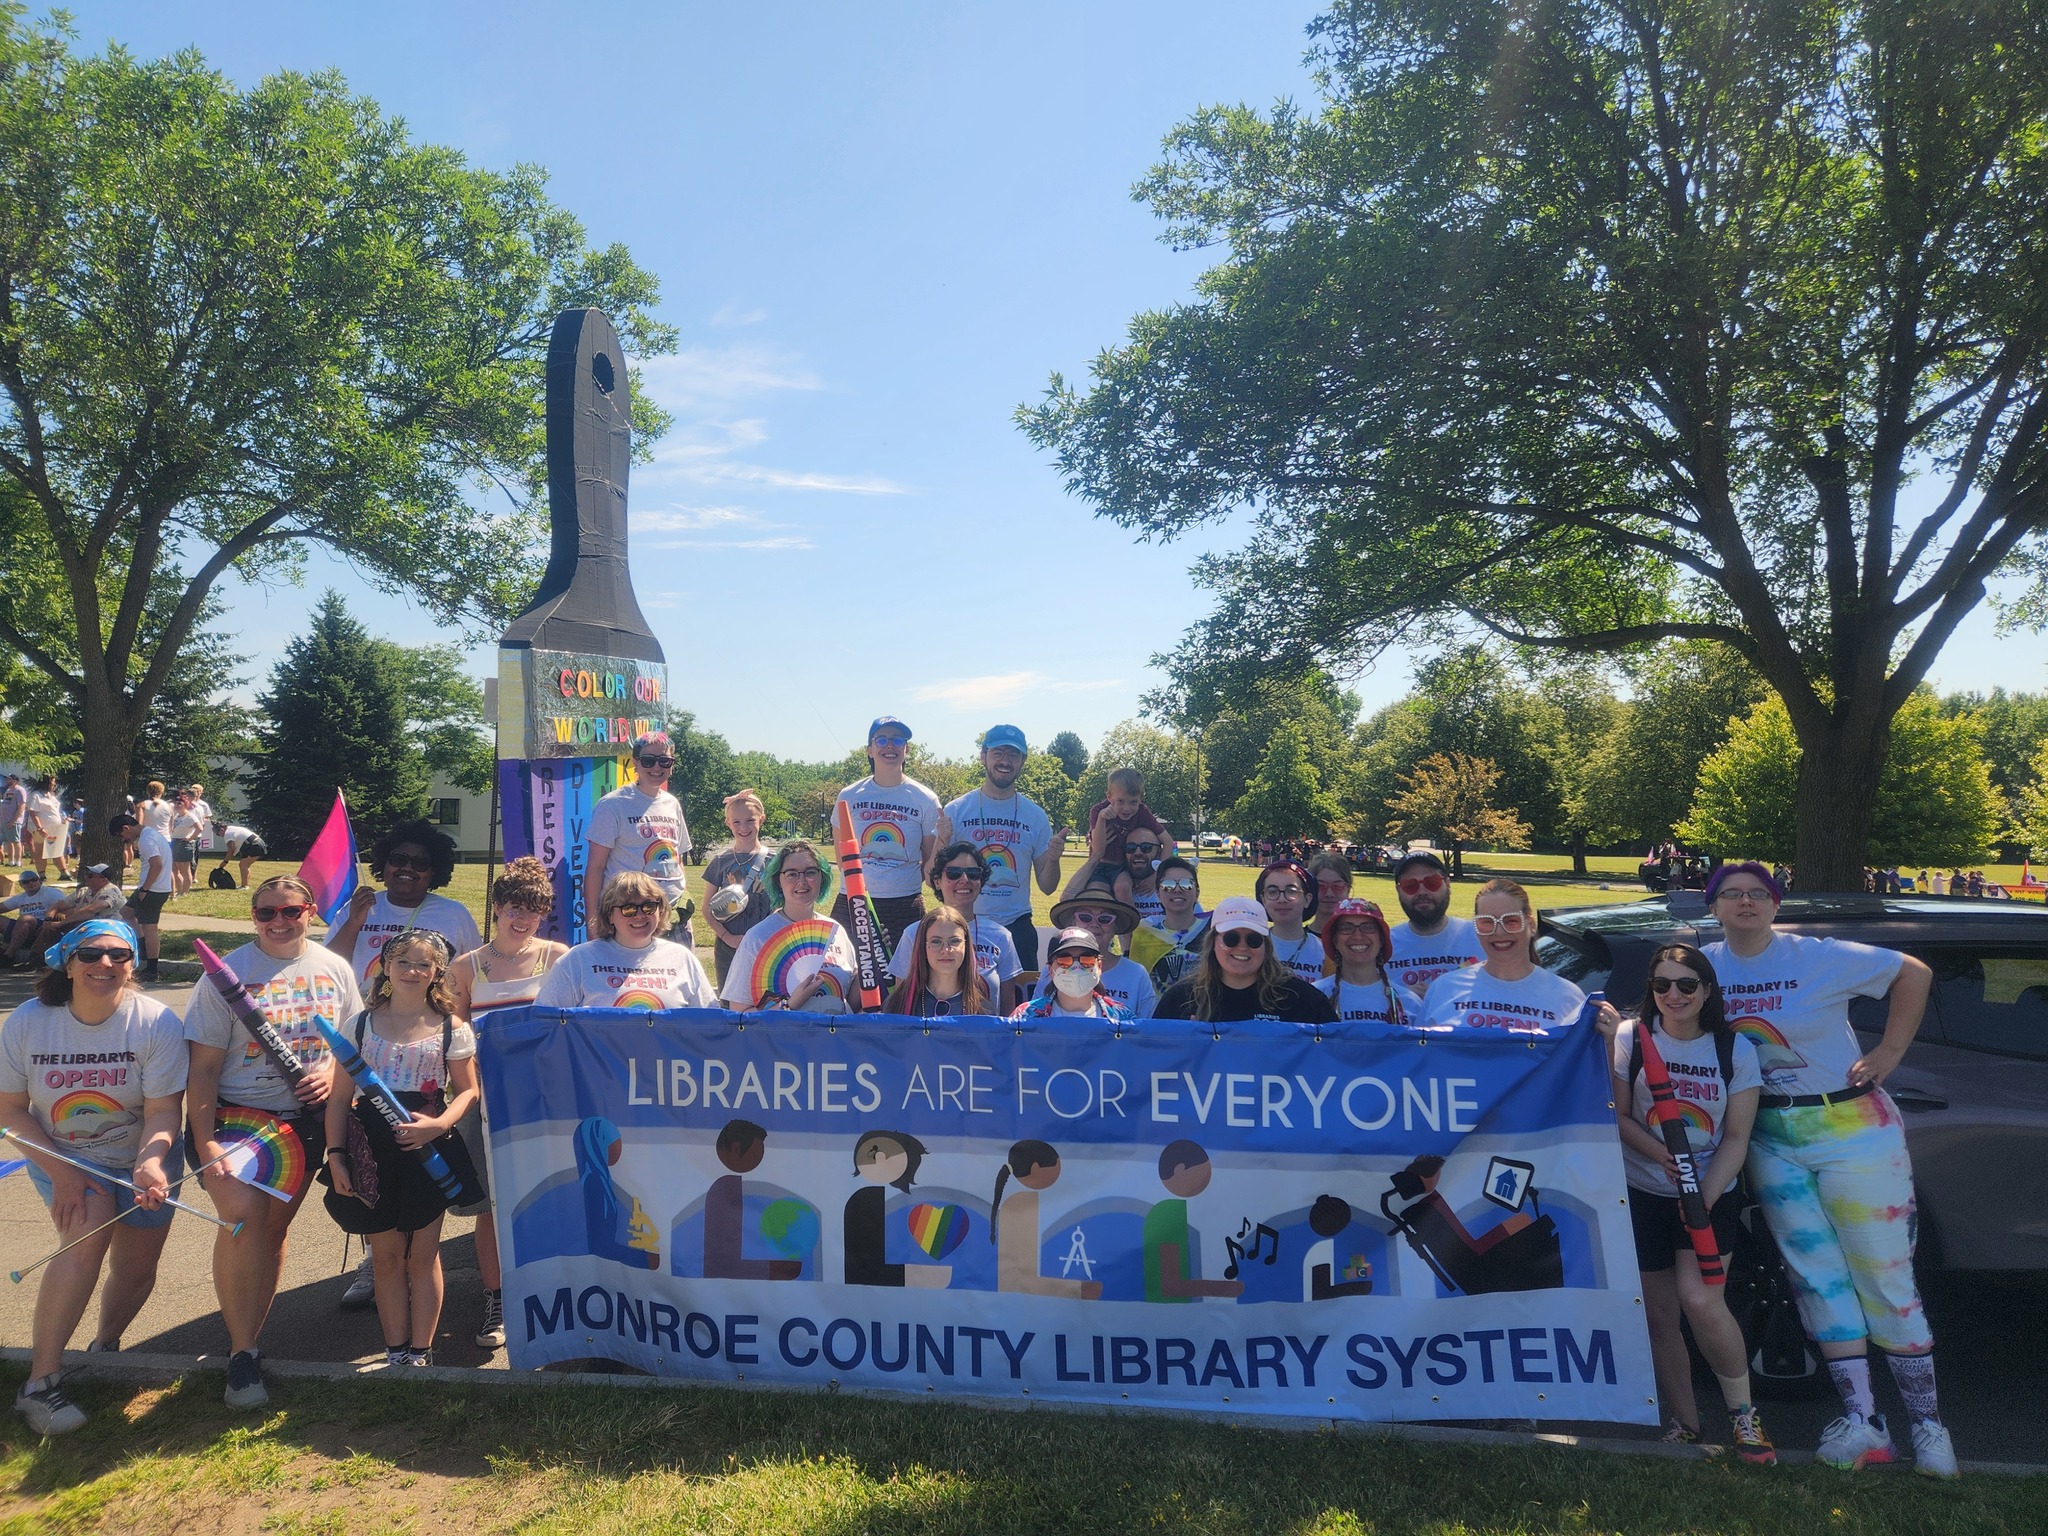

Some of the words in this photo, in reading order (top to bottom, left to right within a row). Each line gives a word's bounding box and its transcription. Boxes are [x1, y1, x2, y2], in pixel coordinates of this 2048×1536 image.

[559, 669, 626, 699] COLOR
[634, 676, 660, 702] OUR
[554, 716, 629, 743] WORLD
[870, 802, 910, 813] LIBRARY
[910, 808, 919, 817] IS
[627, 815, 644, 824] THE
[962, 819, 980, 828] THE
[981, 818, 1021, 828] LIBRARY
[1022, 823, 1030, 832] IS
[972, 828, 1021, 844] OPEN!
[360, 924, 381, 932] THE
[852, 897, 875, 988] ACCEPTANCE
[991, 945, 1000, 956] IS
[1281, 961, 1317, 973] BRARY
[1388, 959, 1411, 969] THE
[1412, 956, 1460, 966] LIBRARY
[592, 965, 615, 973] THE
[616, 967, 665, 975] LIBRARY
[666, 968, 677, 976] IS
[607, 975, 668, 990] OPEN!
[1728, 981, 1782, 995] LIBRARY
[1784, 980, 1798, 990] IS
[245, 975, 335, 1008] READ
[1118, 990, 1128, 999] IS
[1344, 1011, 1387, 1022] LIBRAR
[1454, 1001, 1479, 1010] THE
[1481, 1001, 1540, 1016] LIBRARY
[1542, 1010, 1555, 1020] IS
[1466, 1013, 1540, 1031] OPEN!
[256, 1021, 302, 1073] RESPECT
[31, 1055, 59, 1065] THE
[61, 1052, 127, 1065] LIBRARY
[1666, 1061, 1717, 1078] IBRARY
[45, 1067, 127, 1089] OPEN!
[628, 1057, 882, 1113] LIBRARIES
[901, 1064, 994, 1114] ARE
[1018, 1068, 1127, 1120] FOR
[1150, 1071, 1480, 1133] EVERYONE
[1675, 1153, 1699, 1194] LOVE
[523, 1285, 760, 1365] MONROE
[777, 1316, 1036, 1380] COUNTY
[1055, 1333, 1329, 1389] LIBRARY
[1346, 1327, 1618, 1390] SYSTEM
